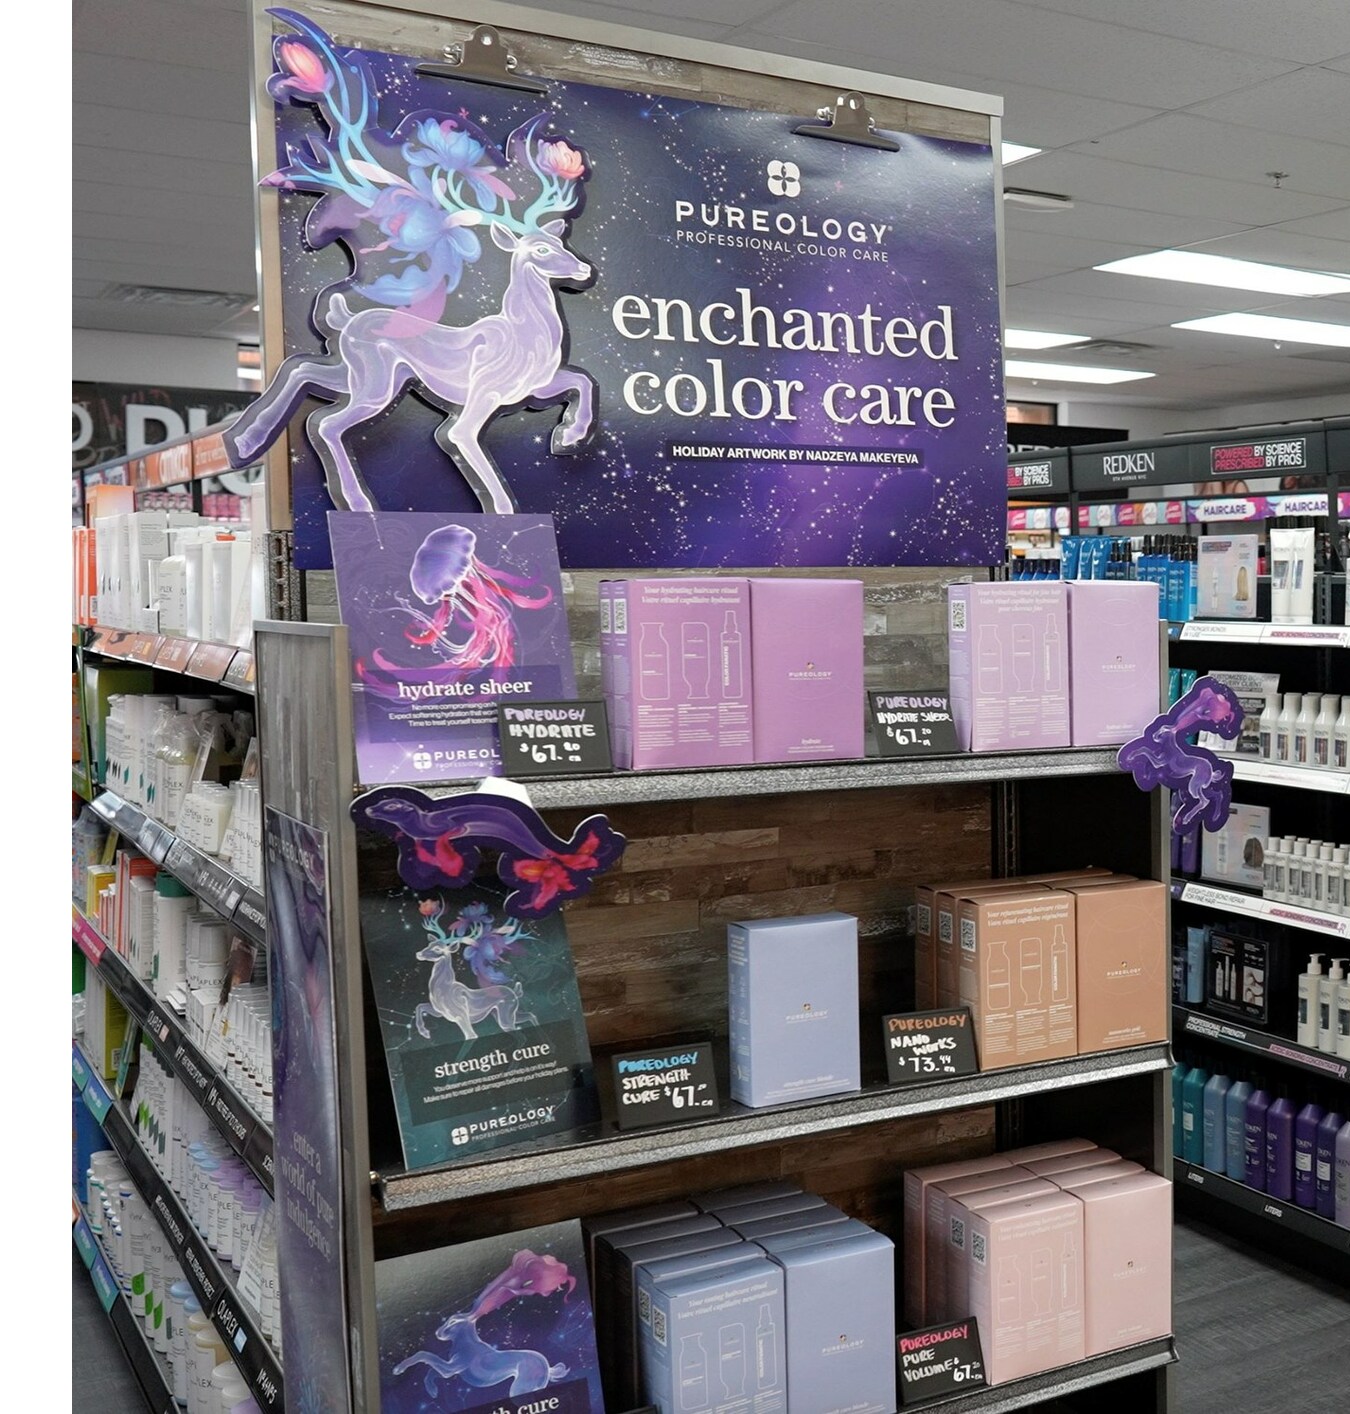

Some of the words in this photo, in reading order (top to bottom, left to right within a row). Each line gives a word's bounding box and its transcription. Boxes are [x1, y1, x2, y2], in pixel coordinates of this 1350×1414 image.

[675, 200, 889, 244] PUREOLOGY
[676, 230, 791, 253] PROFESSIONAL
[797, 242, 847, 259] COLOR
[852, 249, 889, 263] CARE
[611, 287, 959, 361] enchanted
[622, 358, 804, 421] color
[822, 380, 956, 428] care
[672, 445, 725, 459] HOLIDAY
[727, 447, 787, 461] ARTWORK
[789, 449, 806, 461] BY
[806, 450, 858, 463] NADZEYA
[859, 452, 919, 465] MAKEYEVA
[1214, 446, 1254, 460] POWERED
[1254, 445, 1266, 457] BY
[1265, 442, 1302, 456] SCIENCE
[1015, 467, 1023, 477] BY
[1023, 464, 1049, 476] SCIENCE
[1103, 453, 1155, 475] REDKEN
[1214, 456, 1265, 471] PRESCRIBED
[1265, 456, 1278, 467] BY
[1278, 453, 1302, 466] PROS
[1023, 476, 1032, 486] BY
[1032, 474, 1049, 485] PROS
[1203, 504, 1246, 516] HAIRCARE
[396, 681, 475, 701] hydrate
[479, 678, 533, 695] sheer
[876, 696, 948, 711] PUREOLOGY
[504, 708, 586, 722] PUREOLOGY
[876, 712, 919, 724] HYDRATE
[509, 724, 596, 738] HYDRATE
[434, 748, 500, 762] PUREOL
[888, 1014, 966, 1032] PUREOLOGY
[890, 1034, 930, 1049] NANO
[912, 1037, 957, 1056] WORKS
[434, 1049, 509, 1079] strength
[512, 1043, 551, 1061] cure
[618, 1051, 698, 1073] PUREOLOGY
[622, 1068, 691, 1090] STRENGTH
[622, 1089, 661, 1105] CURE
[469, 1105, 556, 1134] PUREOLOGY
[293, 1131, 315, 1168] enter
[281, 1155, 306, 1196] world
[1264, 1204, 1282, 1218] LITERS
[287, 1190, 331, 1263] indulgence
[216, 1299, 239, 1339] OLAPLEX
[900, 1325, 968, 1354] PUREOLOGY
[902, 1348, 935, 1368] PURE
[517, 1397, 560, 1414] cure
